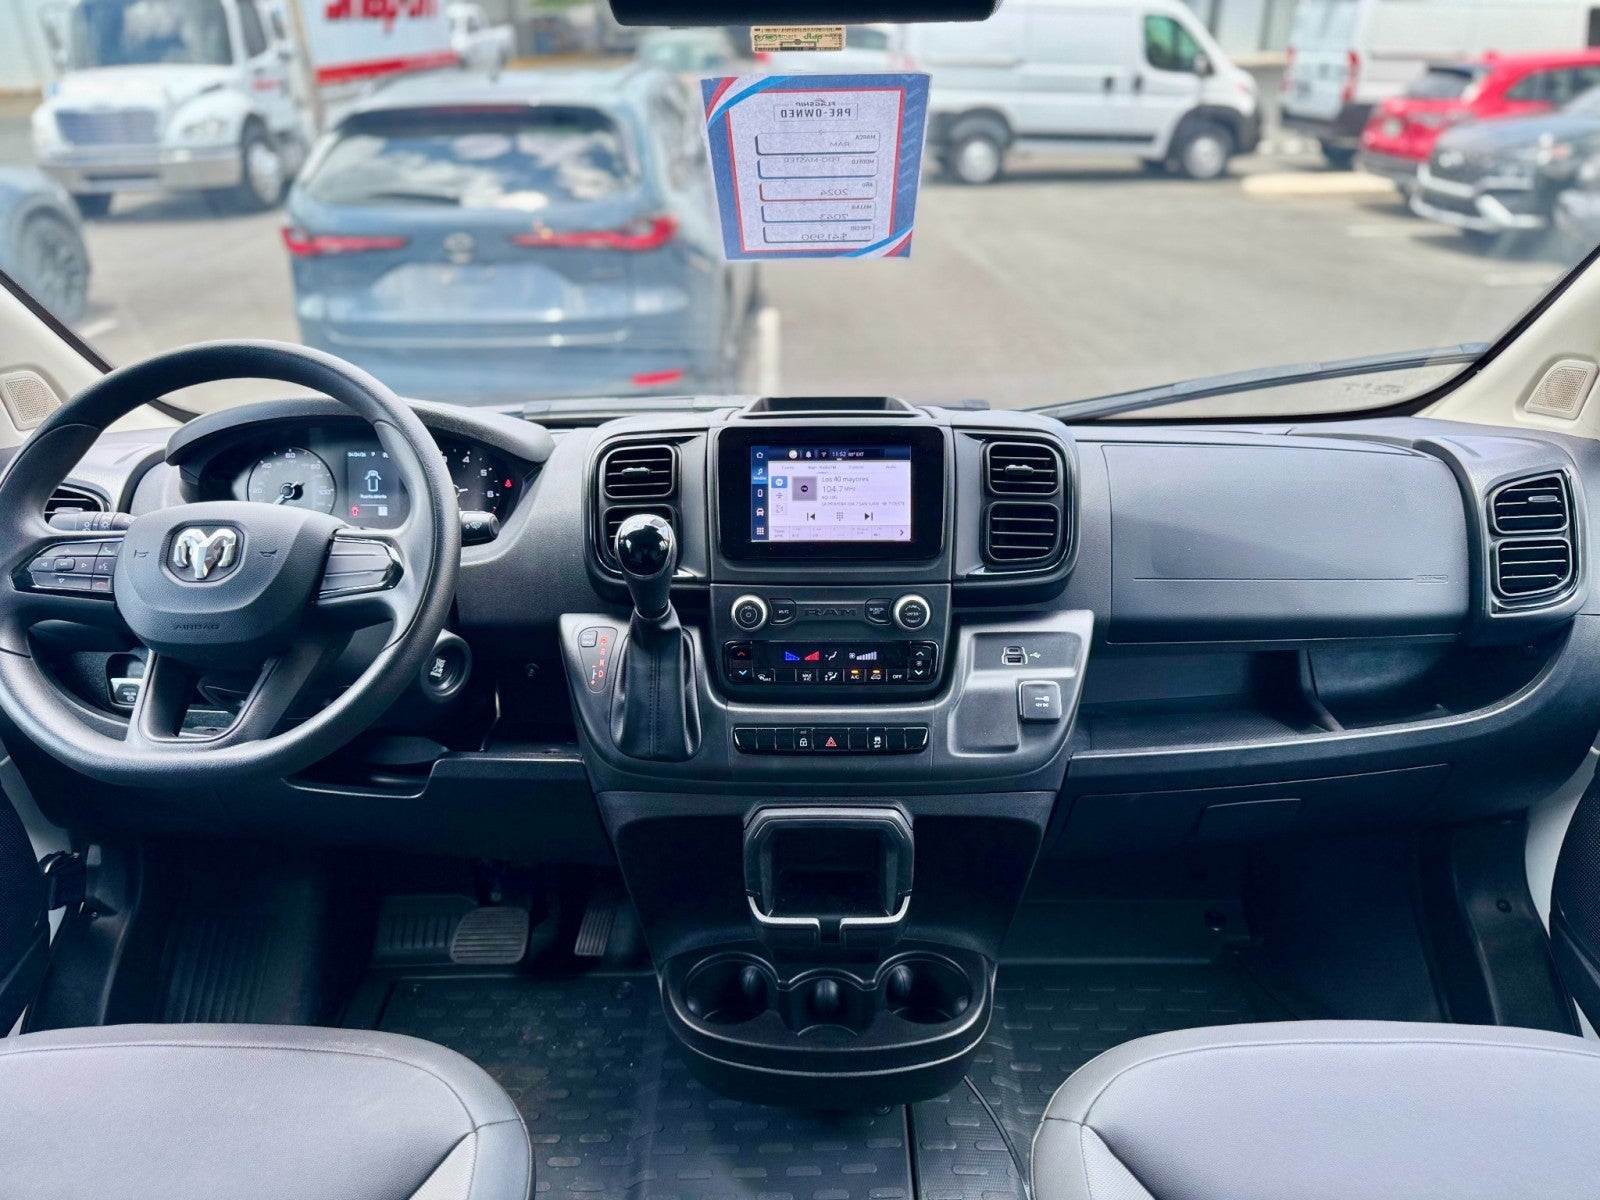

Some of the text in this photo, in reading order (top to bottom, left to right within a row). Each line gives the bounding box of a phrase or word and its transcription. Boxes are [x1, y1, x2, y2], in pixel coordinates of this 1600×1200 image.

[842, 476, 869, 484] mayores
[804, 607, 857, 616] RAM
[598, 670, 604, 678] D
